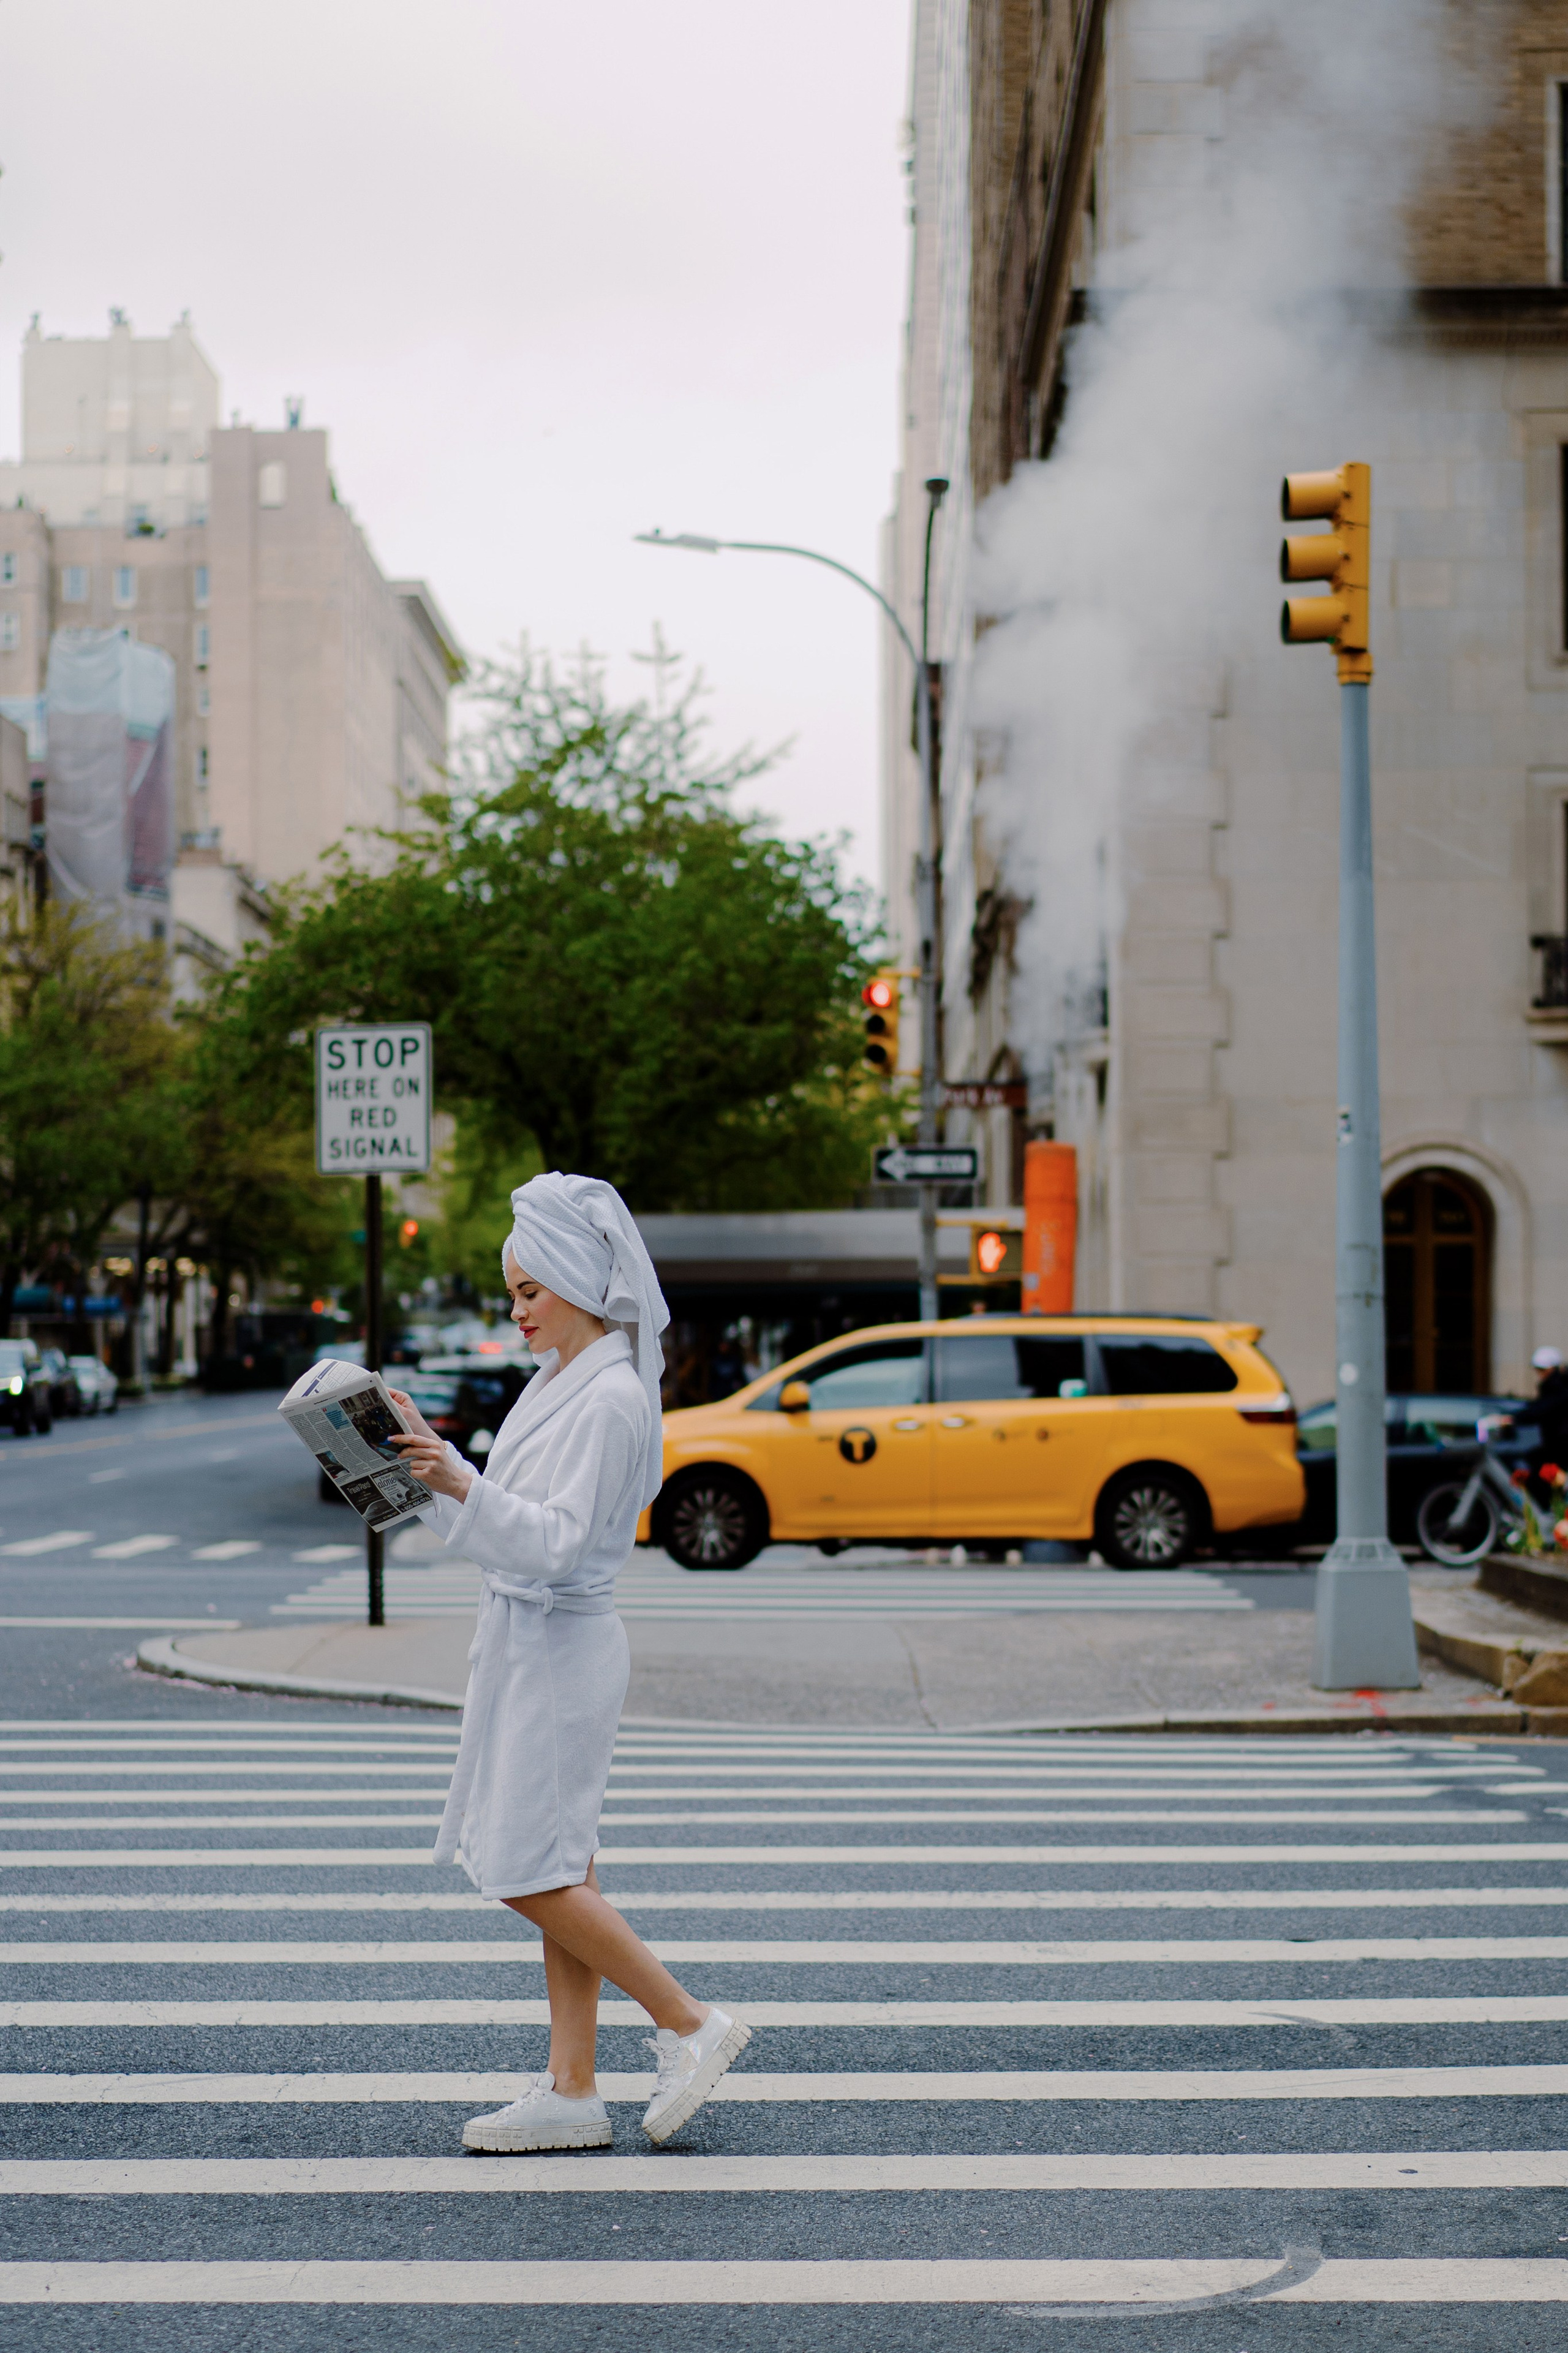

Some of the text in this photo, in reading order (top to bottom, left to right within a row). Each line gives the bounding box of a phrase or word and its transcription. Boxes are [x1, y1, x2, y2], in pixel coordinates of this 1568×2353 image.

[327, 1037, 420, 1070] STOP
[327, 1077, 420, 1100] HERE ON
[350, 1107, 397, 1128] RED
[329, 1137, 418, 1160] SIGNAL
[843, 1430, 870, 1461] T
[377, 1477, 396, 1489] alone
